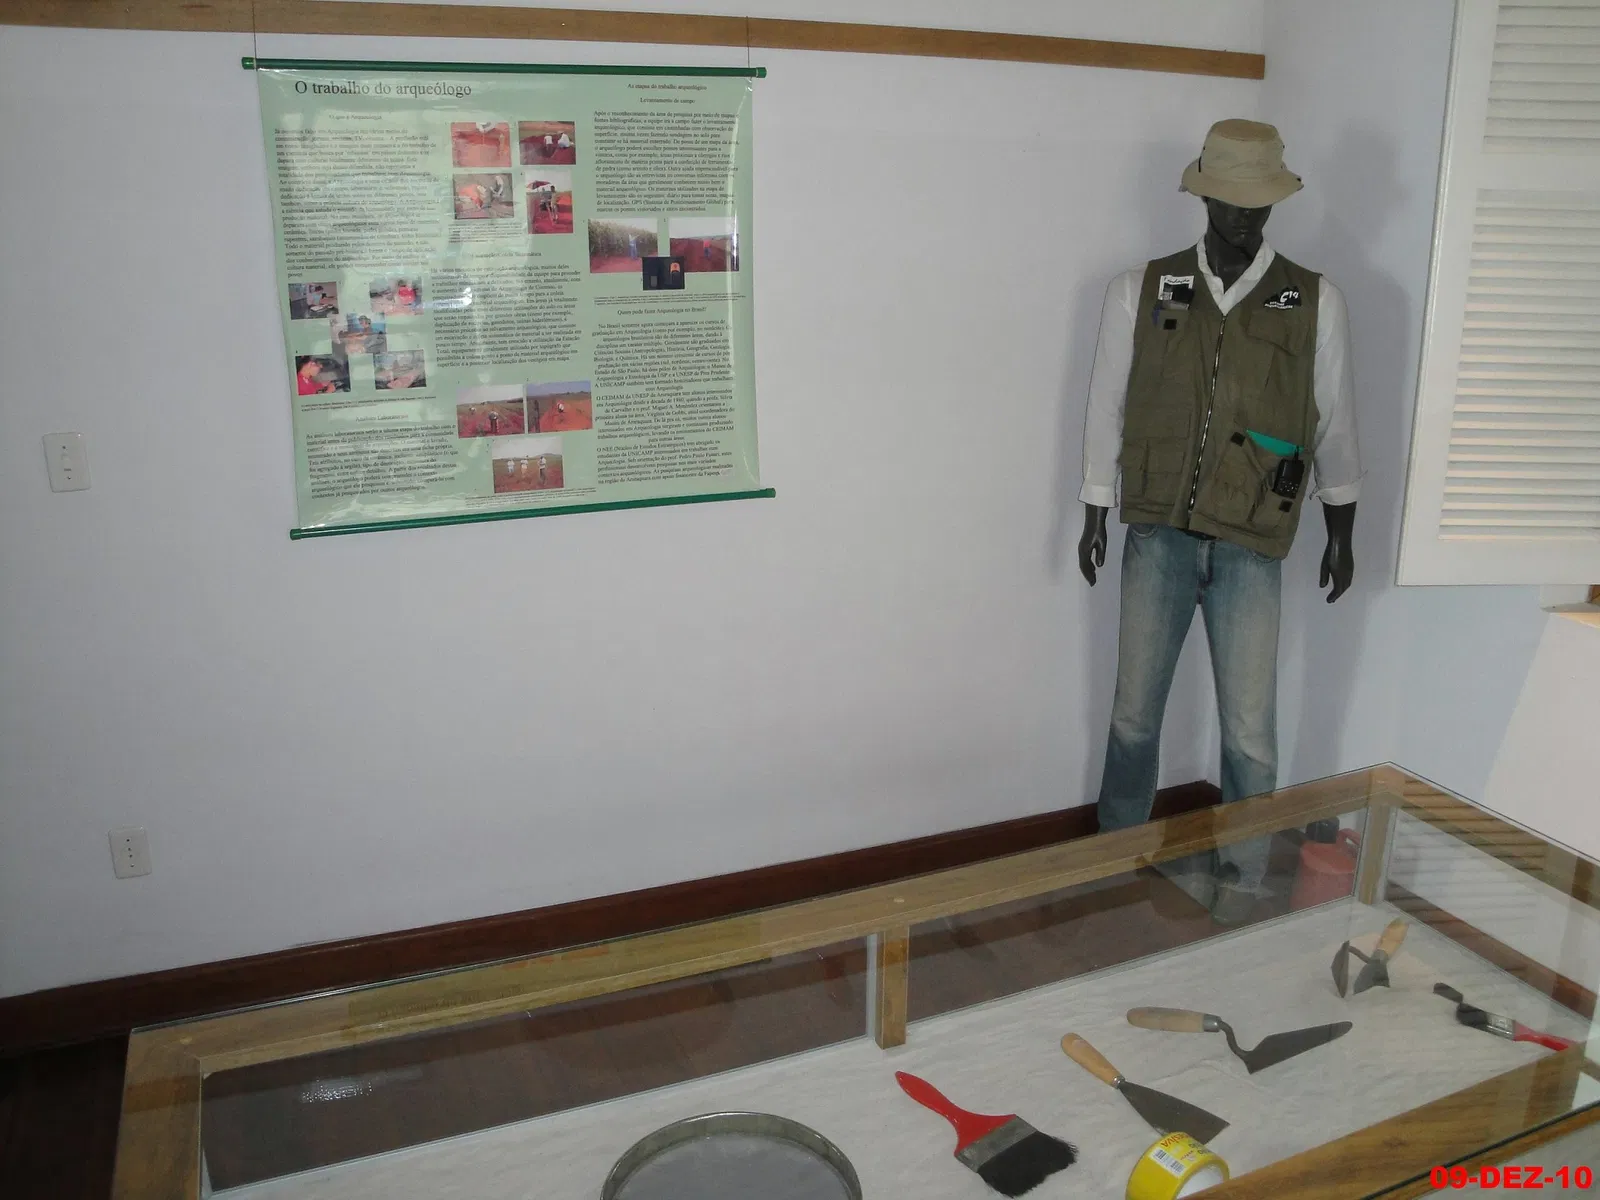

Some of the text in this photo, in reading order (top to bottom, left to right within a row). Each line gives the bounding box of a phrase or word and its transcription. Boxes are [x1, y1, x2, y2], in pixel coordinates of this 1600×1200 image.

[295, 81, 472, 98] O trabalho do arqueólogo
